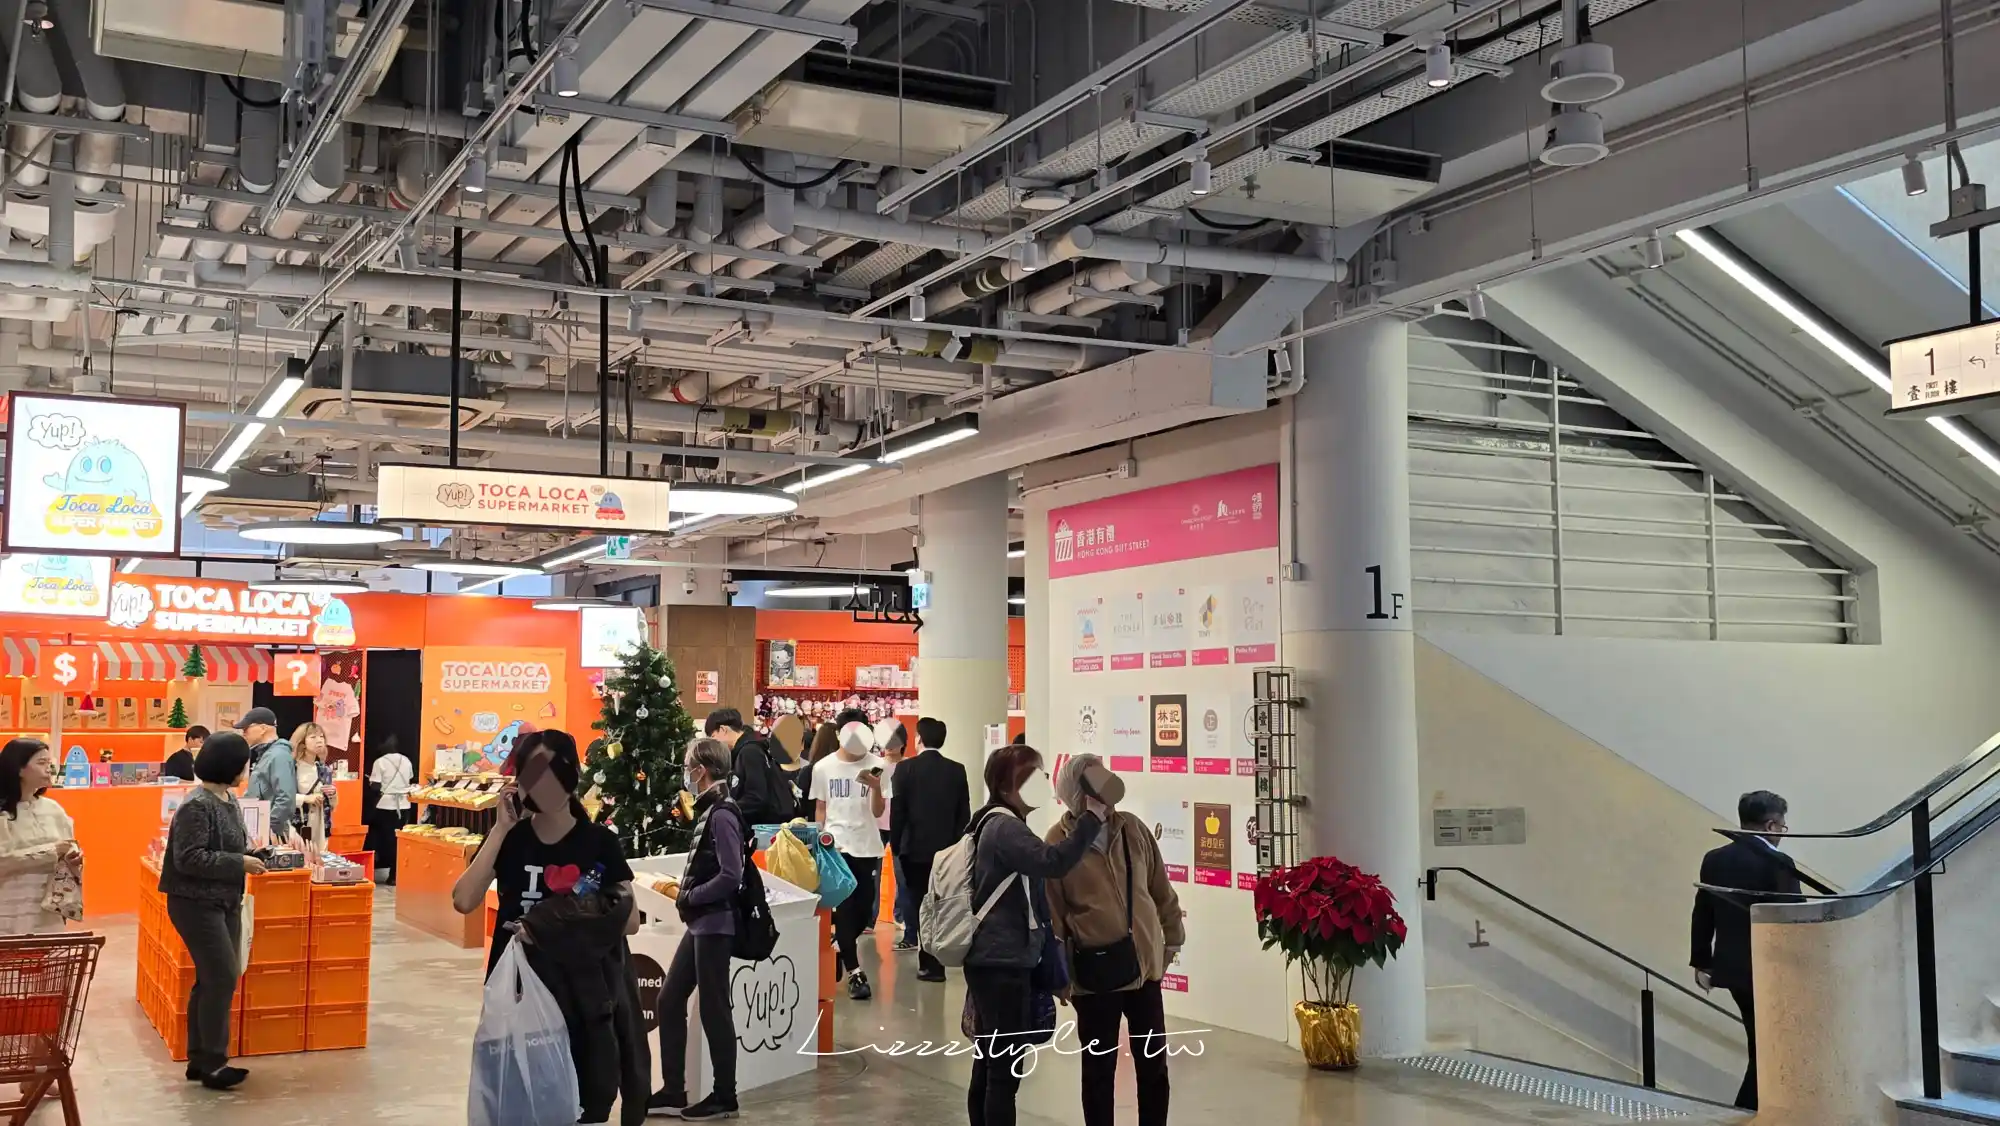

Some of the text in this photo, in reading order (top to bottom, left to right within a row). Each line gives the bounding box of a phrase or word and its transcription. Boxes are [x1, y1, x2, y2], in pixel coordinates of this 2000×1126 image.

[1924, 347, 1935, 376] 1
[1943, 379, 1958, 396] 樓
[41, 421, 76, 442] Yup!
[444, 488, 468, 501] Yup!
[478, 483, 531, 499] TOCA
[538, 486, 589, 502] LOCA
[56, 494, 152, 515] Toca Loca
[478, 499, 590, 515] SUPERMARKET
[1077, 539, 1150, 559] HONG KONG GIFT STREET
[30, 576, 93, 592] Toca Loca
[112, 593, 145, 617] Yup!
[155, 584, 311, 616] TOCA LOCA
[154, 611, 312, 637] SUPERMARKET
[444, 664, 548, 678] TOCA LOCA
[444, 679, 548, 690] SUPERMARKET
[1157, 709, 1181, 723] 林記
[829, 779, 850, 798] POLO
[521, 865, 544, 899] I
[743, 971, 788, 1029] Yup!
